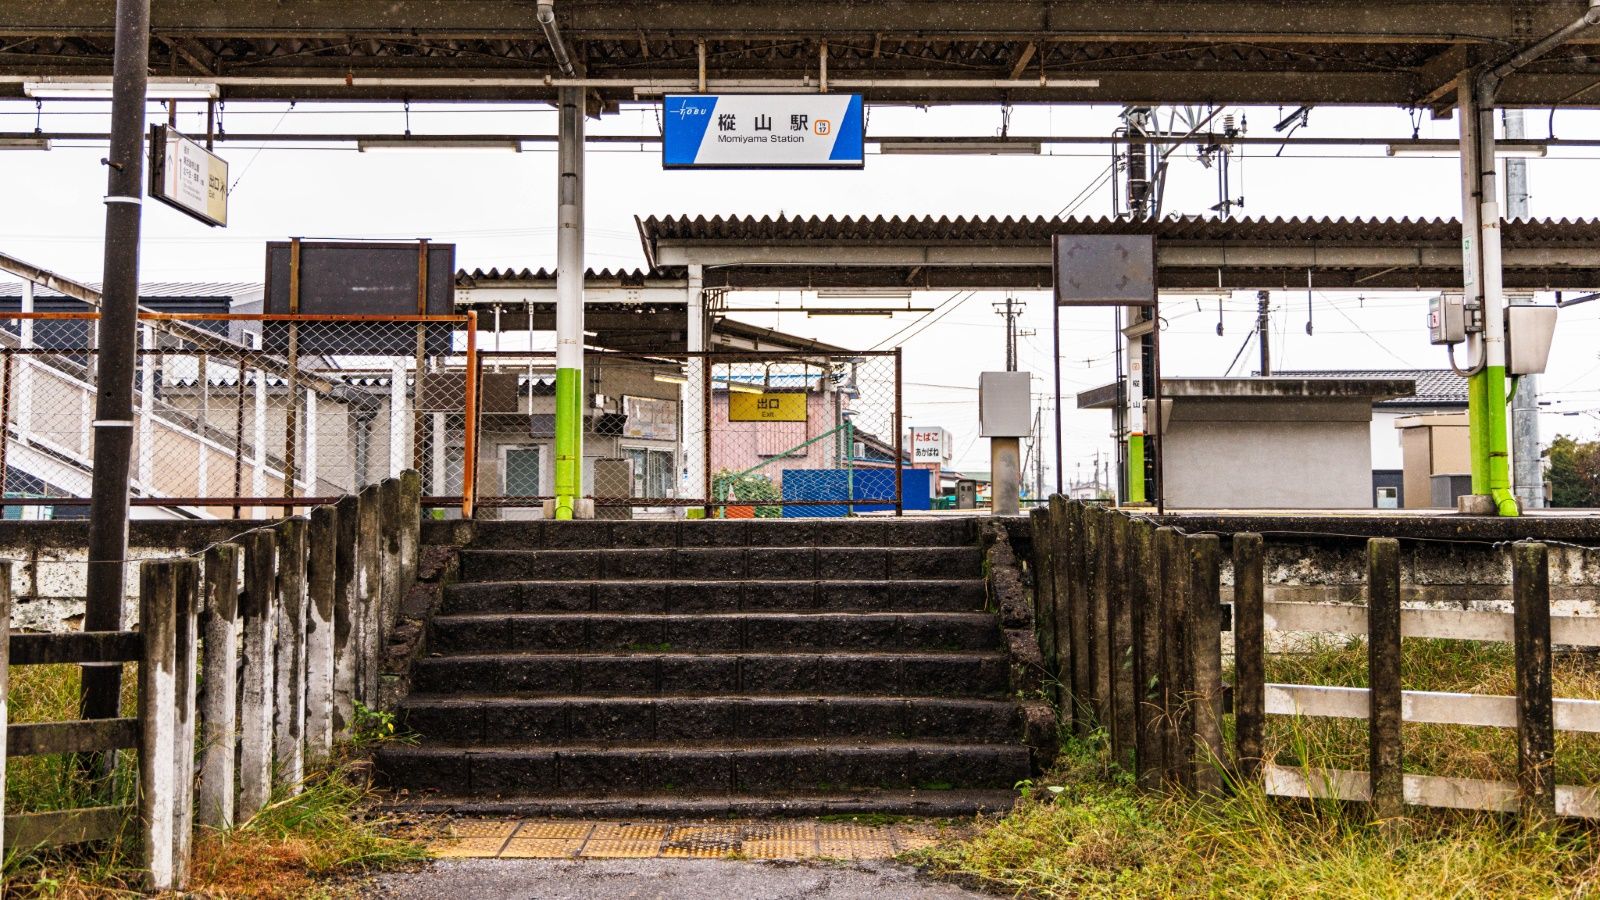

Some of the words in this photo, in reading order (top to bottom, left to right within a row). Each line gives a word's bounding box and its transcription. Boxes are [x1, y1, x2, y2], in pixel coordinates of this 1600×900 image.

[718, 134, 767, 144] Momiyama
[770, 134, 804, 143] Station
[757, 398, 779, 409] 出口
[915, 432, 939, 442] たばこ
[915, 447, 940, 457] あかばね
